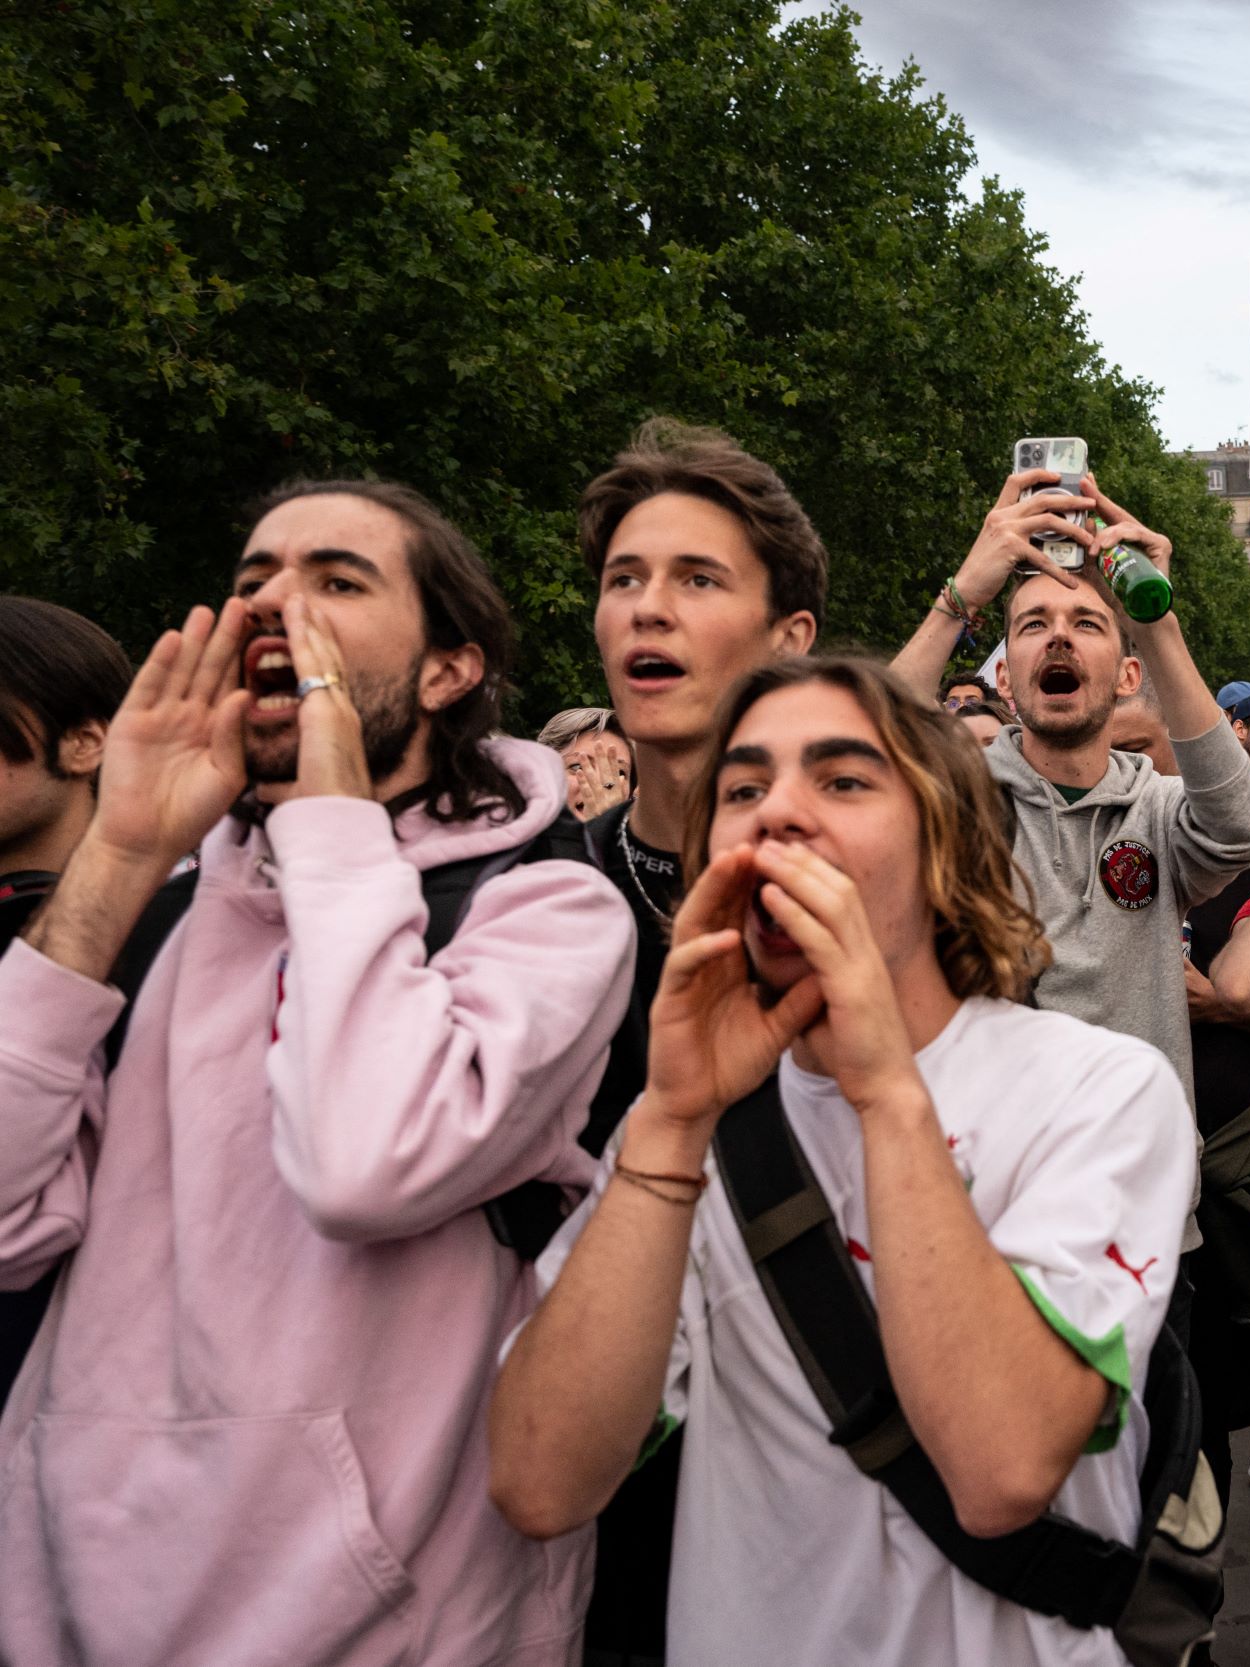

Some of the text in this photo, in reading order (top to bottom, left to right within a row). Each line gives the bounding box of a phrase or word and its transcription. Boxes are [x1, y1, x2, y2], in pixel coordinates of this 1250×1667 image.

[1103, 841, 1151, 862] PAS DE JUSTICE
[1138, 894, 1152, 907] PAIX
